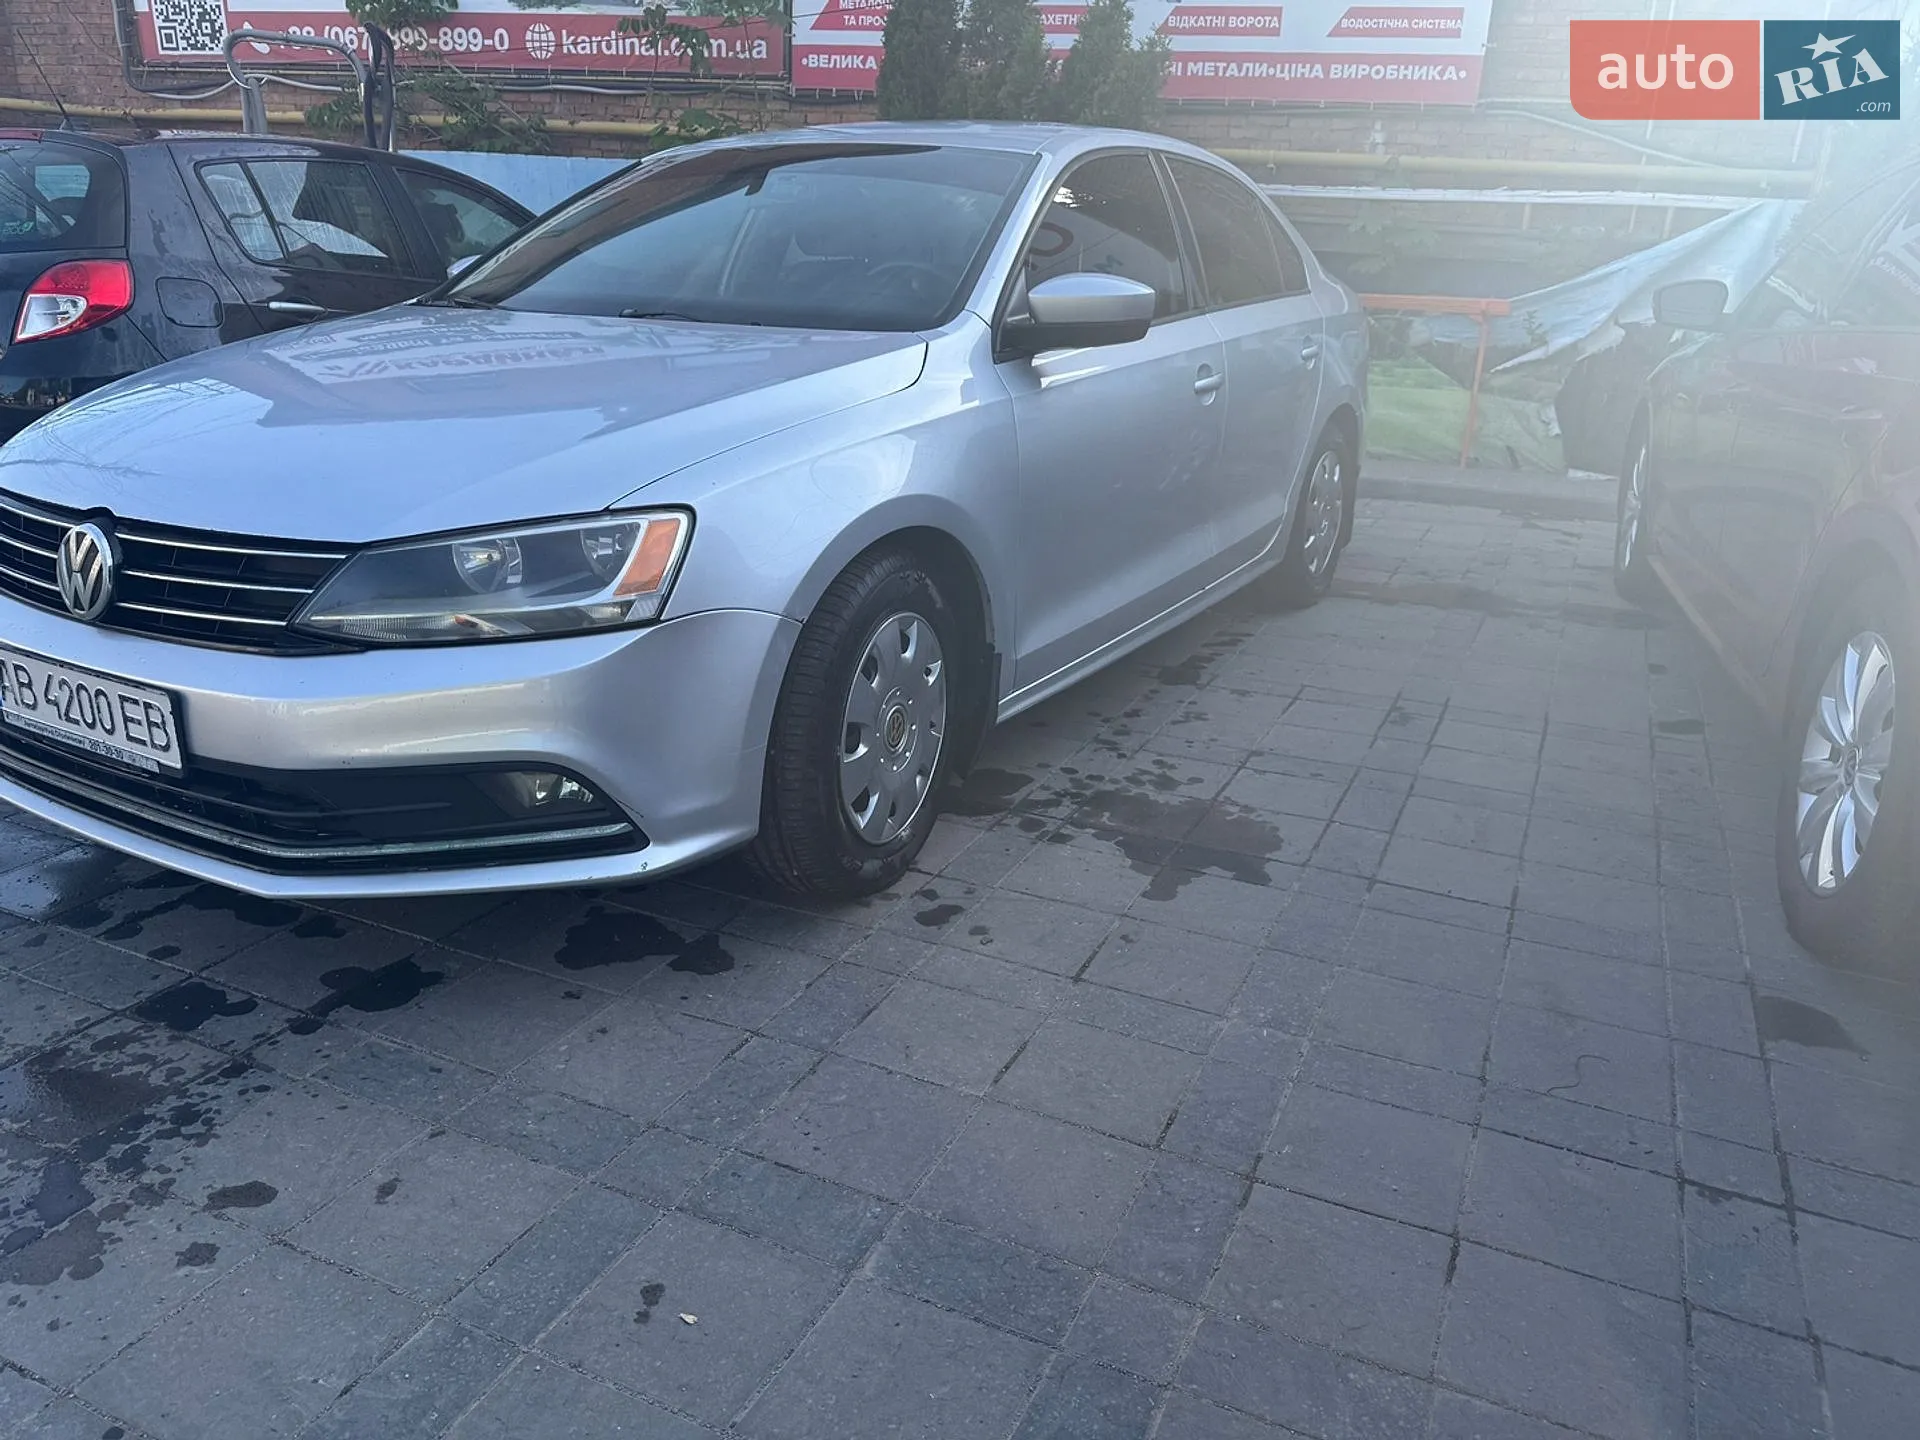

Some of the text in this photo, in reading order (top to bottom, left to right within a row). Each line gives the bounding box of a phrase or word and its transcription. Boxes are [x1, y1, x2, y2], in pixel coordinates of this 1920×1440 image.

[843, 15, 857, 26] ТА
[1038, 14, 1080, 26] АХЕТН
[1168, 15, 1280, 29] ВІДКАТНІ ВОРОТА
[1341, 18, 1465, 30] ВОДОСТІЧНА СИСТЕМА
[807, 54, 877, 70] ВЕЛИКА
[1329, 64, 1457, 81] ВИРОБНИКА
[44, 672, 116, 736] 4200
